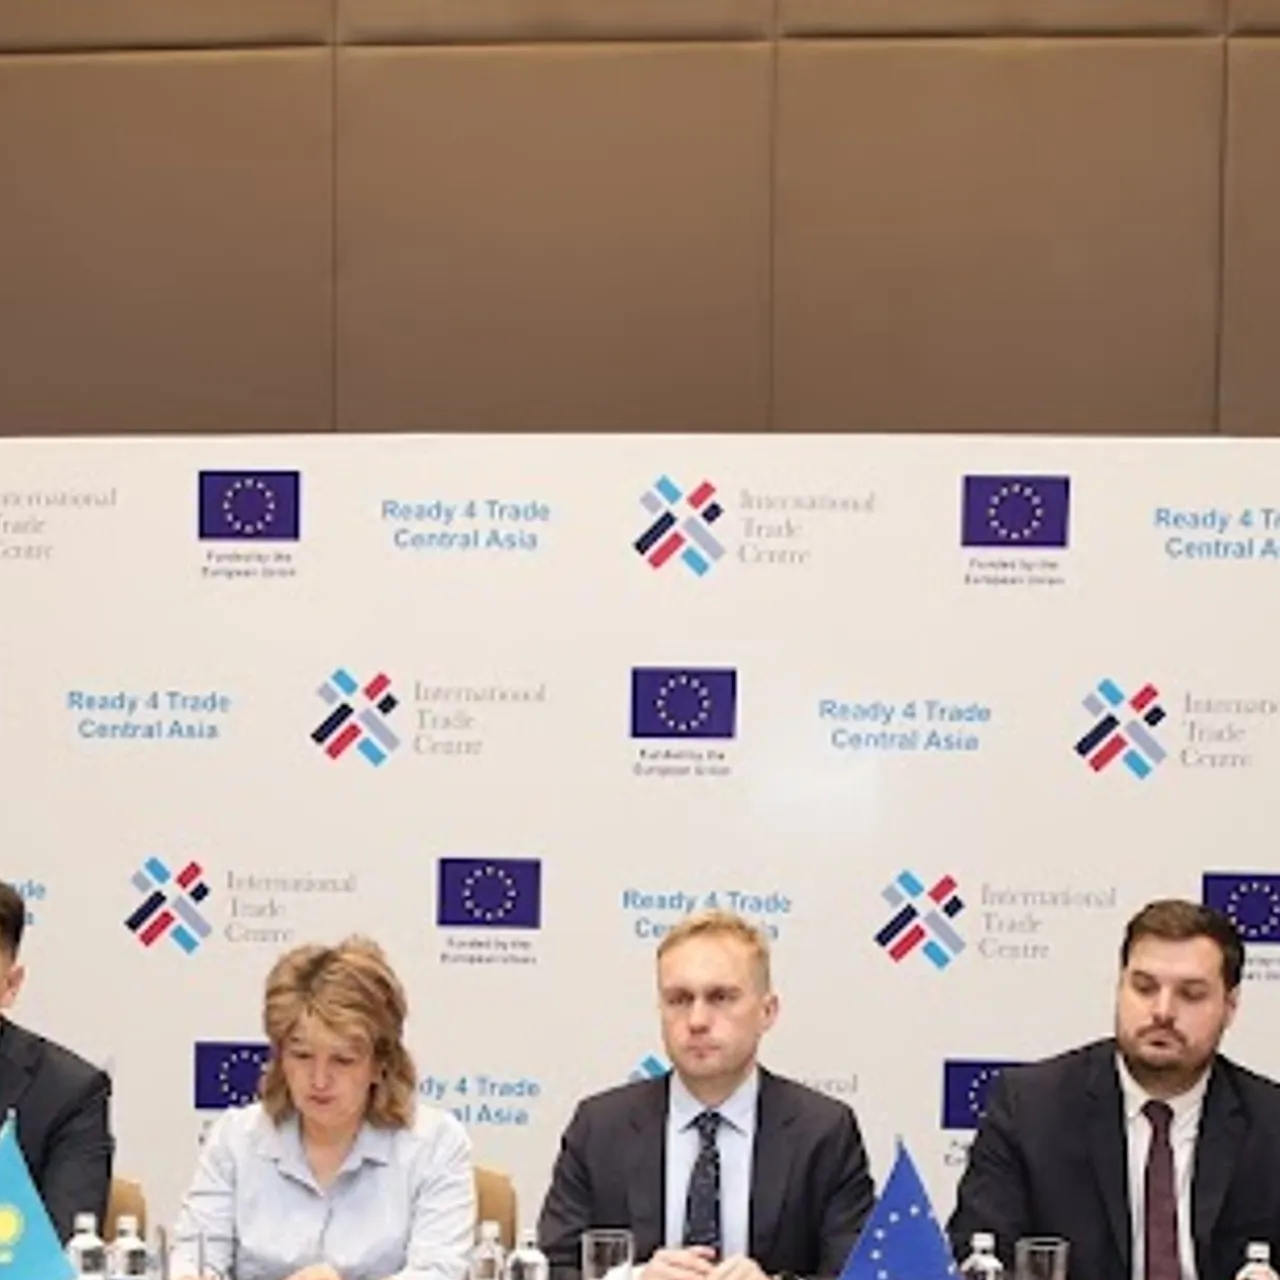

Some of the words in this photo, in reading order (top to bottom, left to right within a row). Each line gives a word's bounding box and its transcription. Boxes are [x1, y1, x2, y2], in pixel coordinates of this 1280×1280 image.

[382, 499, 451, 524] Ready
[463, 500, 477, 520] 4
[1154, 508, 1229, 533] Ready
[1239, 508, 1253, 528] 4
[393, 529, 479, 550] Central
[484, 528, 538, 550] Asia
[1165, 538, 1256, 560] Central
[67, 691, 137, 715] Ready
[146, 692, 158, 711] 4
[819, 700, 894, 726] Ready
[902, 701, 916, 719] 4
[78, 719, 163, 740] Central
[168, 719, 218, 740] Asia
[831, 729, 919, 751] Central
[924, 729, 979, 752] Asia
[623, 890, 697, 912] Ready
[704, 891, 718, 908] 4
[455, 1077, 469, 1095] 4
[476, 1106, 529, 1126] Asia
